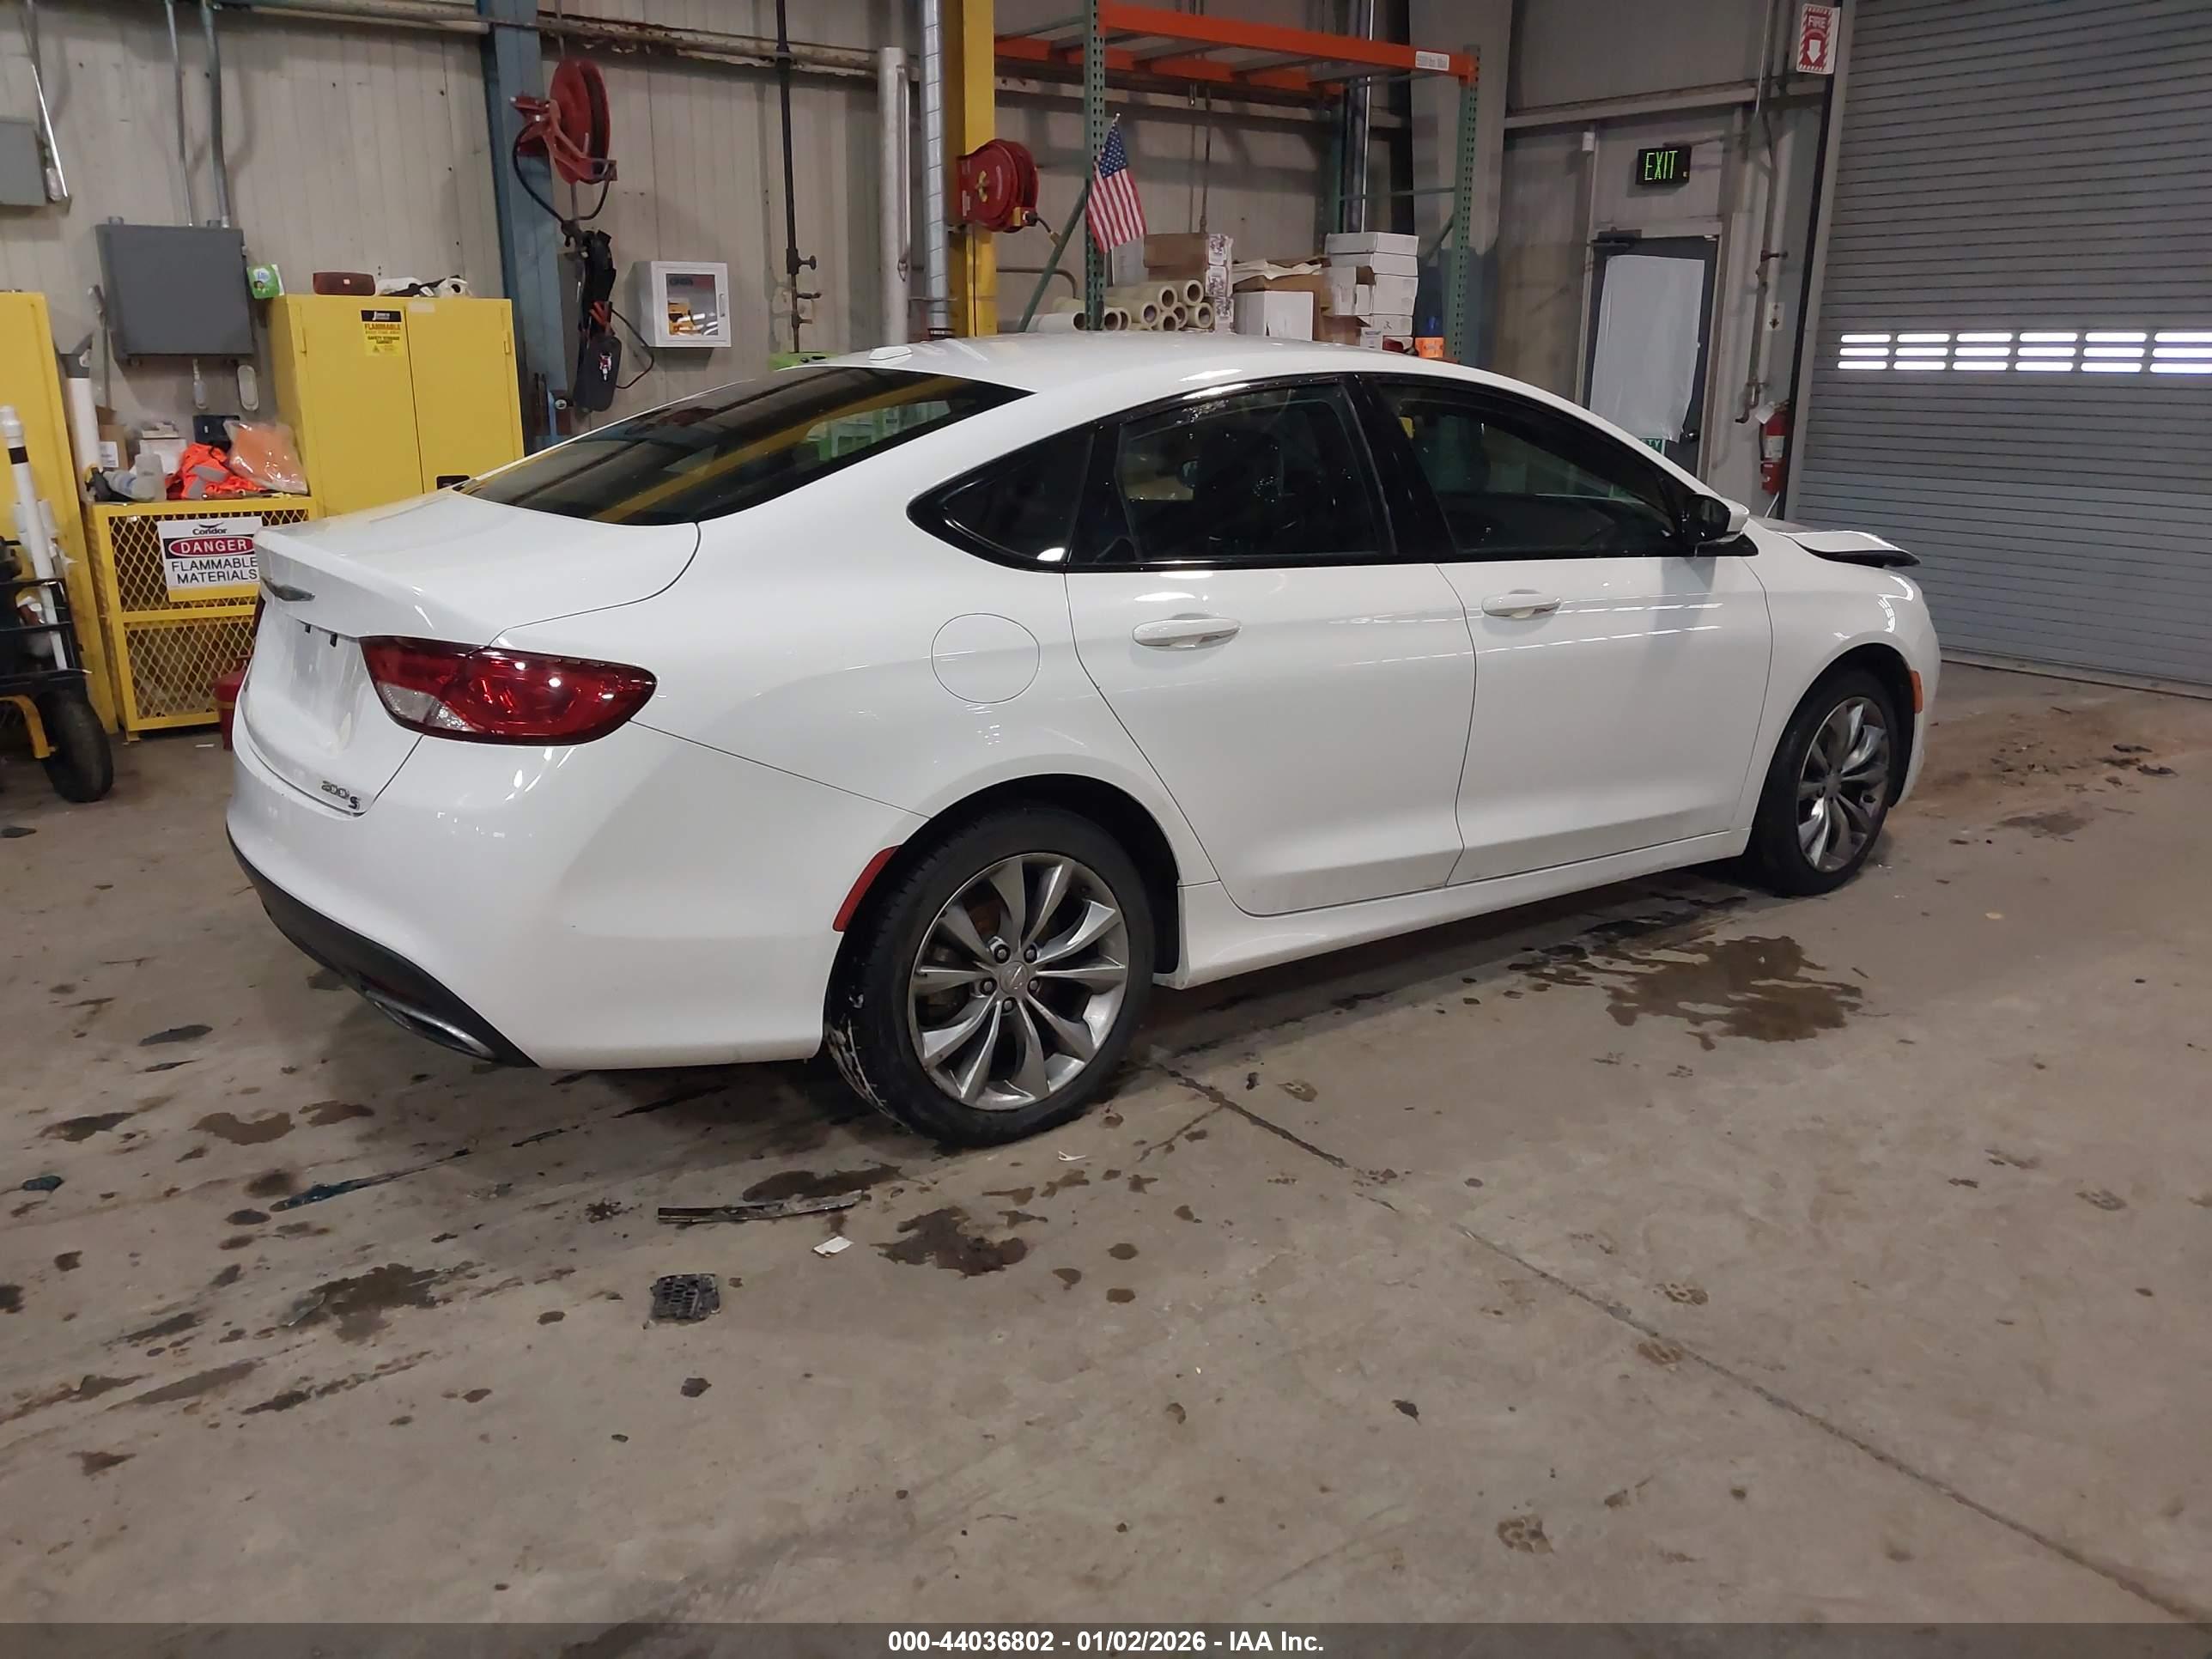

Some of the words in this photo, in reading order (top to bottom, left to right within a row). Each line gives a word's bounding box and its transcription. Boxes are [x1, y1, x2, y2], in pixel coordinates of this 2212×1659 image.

[1808, 15, 1827, 28] FIRE
[1644, 150, 1678, 180] EXIT
[180, 539, 247, 554] DANGER
[172, 557, 258, 572] FLAMMABLE
[177, 568, 258, 584] MATERIALS
[321, 781, 349, 799] 200
[348, 796, 361, 810] S
